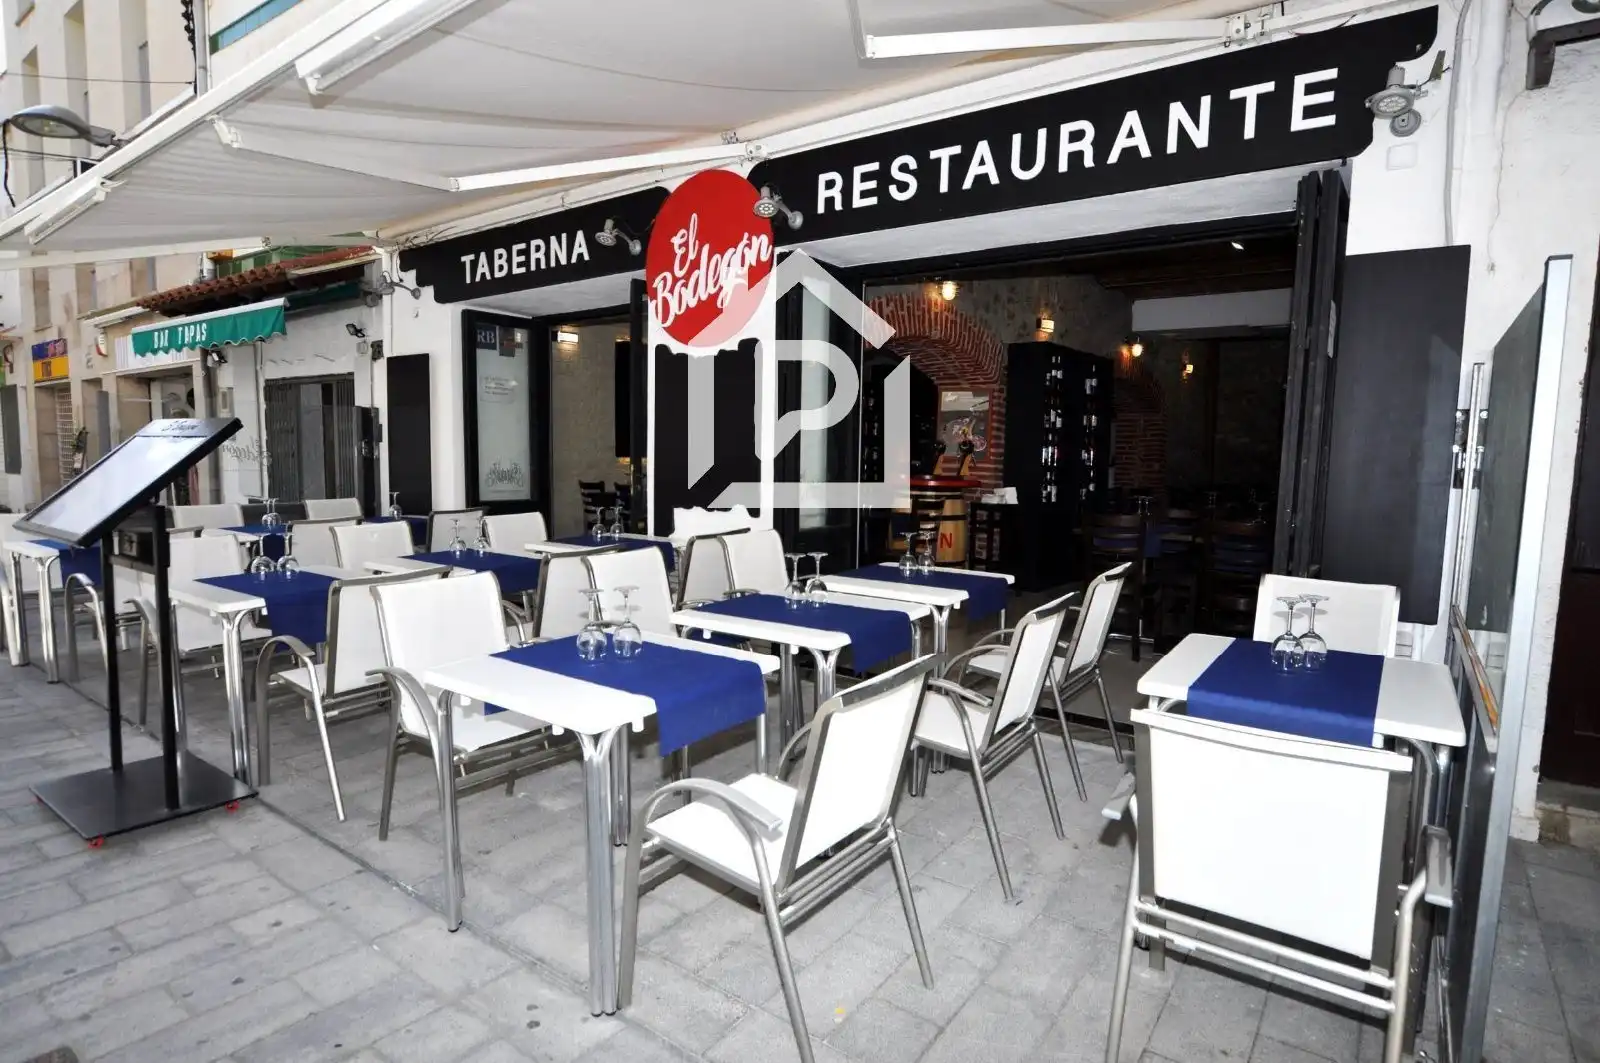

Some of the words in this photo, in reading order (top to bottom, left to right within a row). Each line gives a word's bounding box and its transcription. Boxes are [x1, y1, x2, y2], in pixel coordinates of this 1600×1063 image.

[817, 67, 1339, 215] RESTAURANTE
[460, 229, 590, 284] TABERNA
[670, 212, 699, 278] El
[649, 232, 773, 328] Bodegón
[153, 329, 169, 349] BAR
[178, 322, 207, 344] TAPAS
